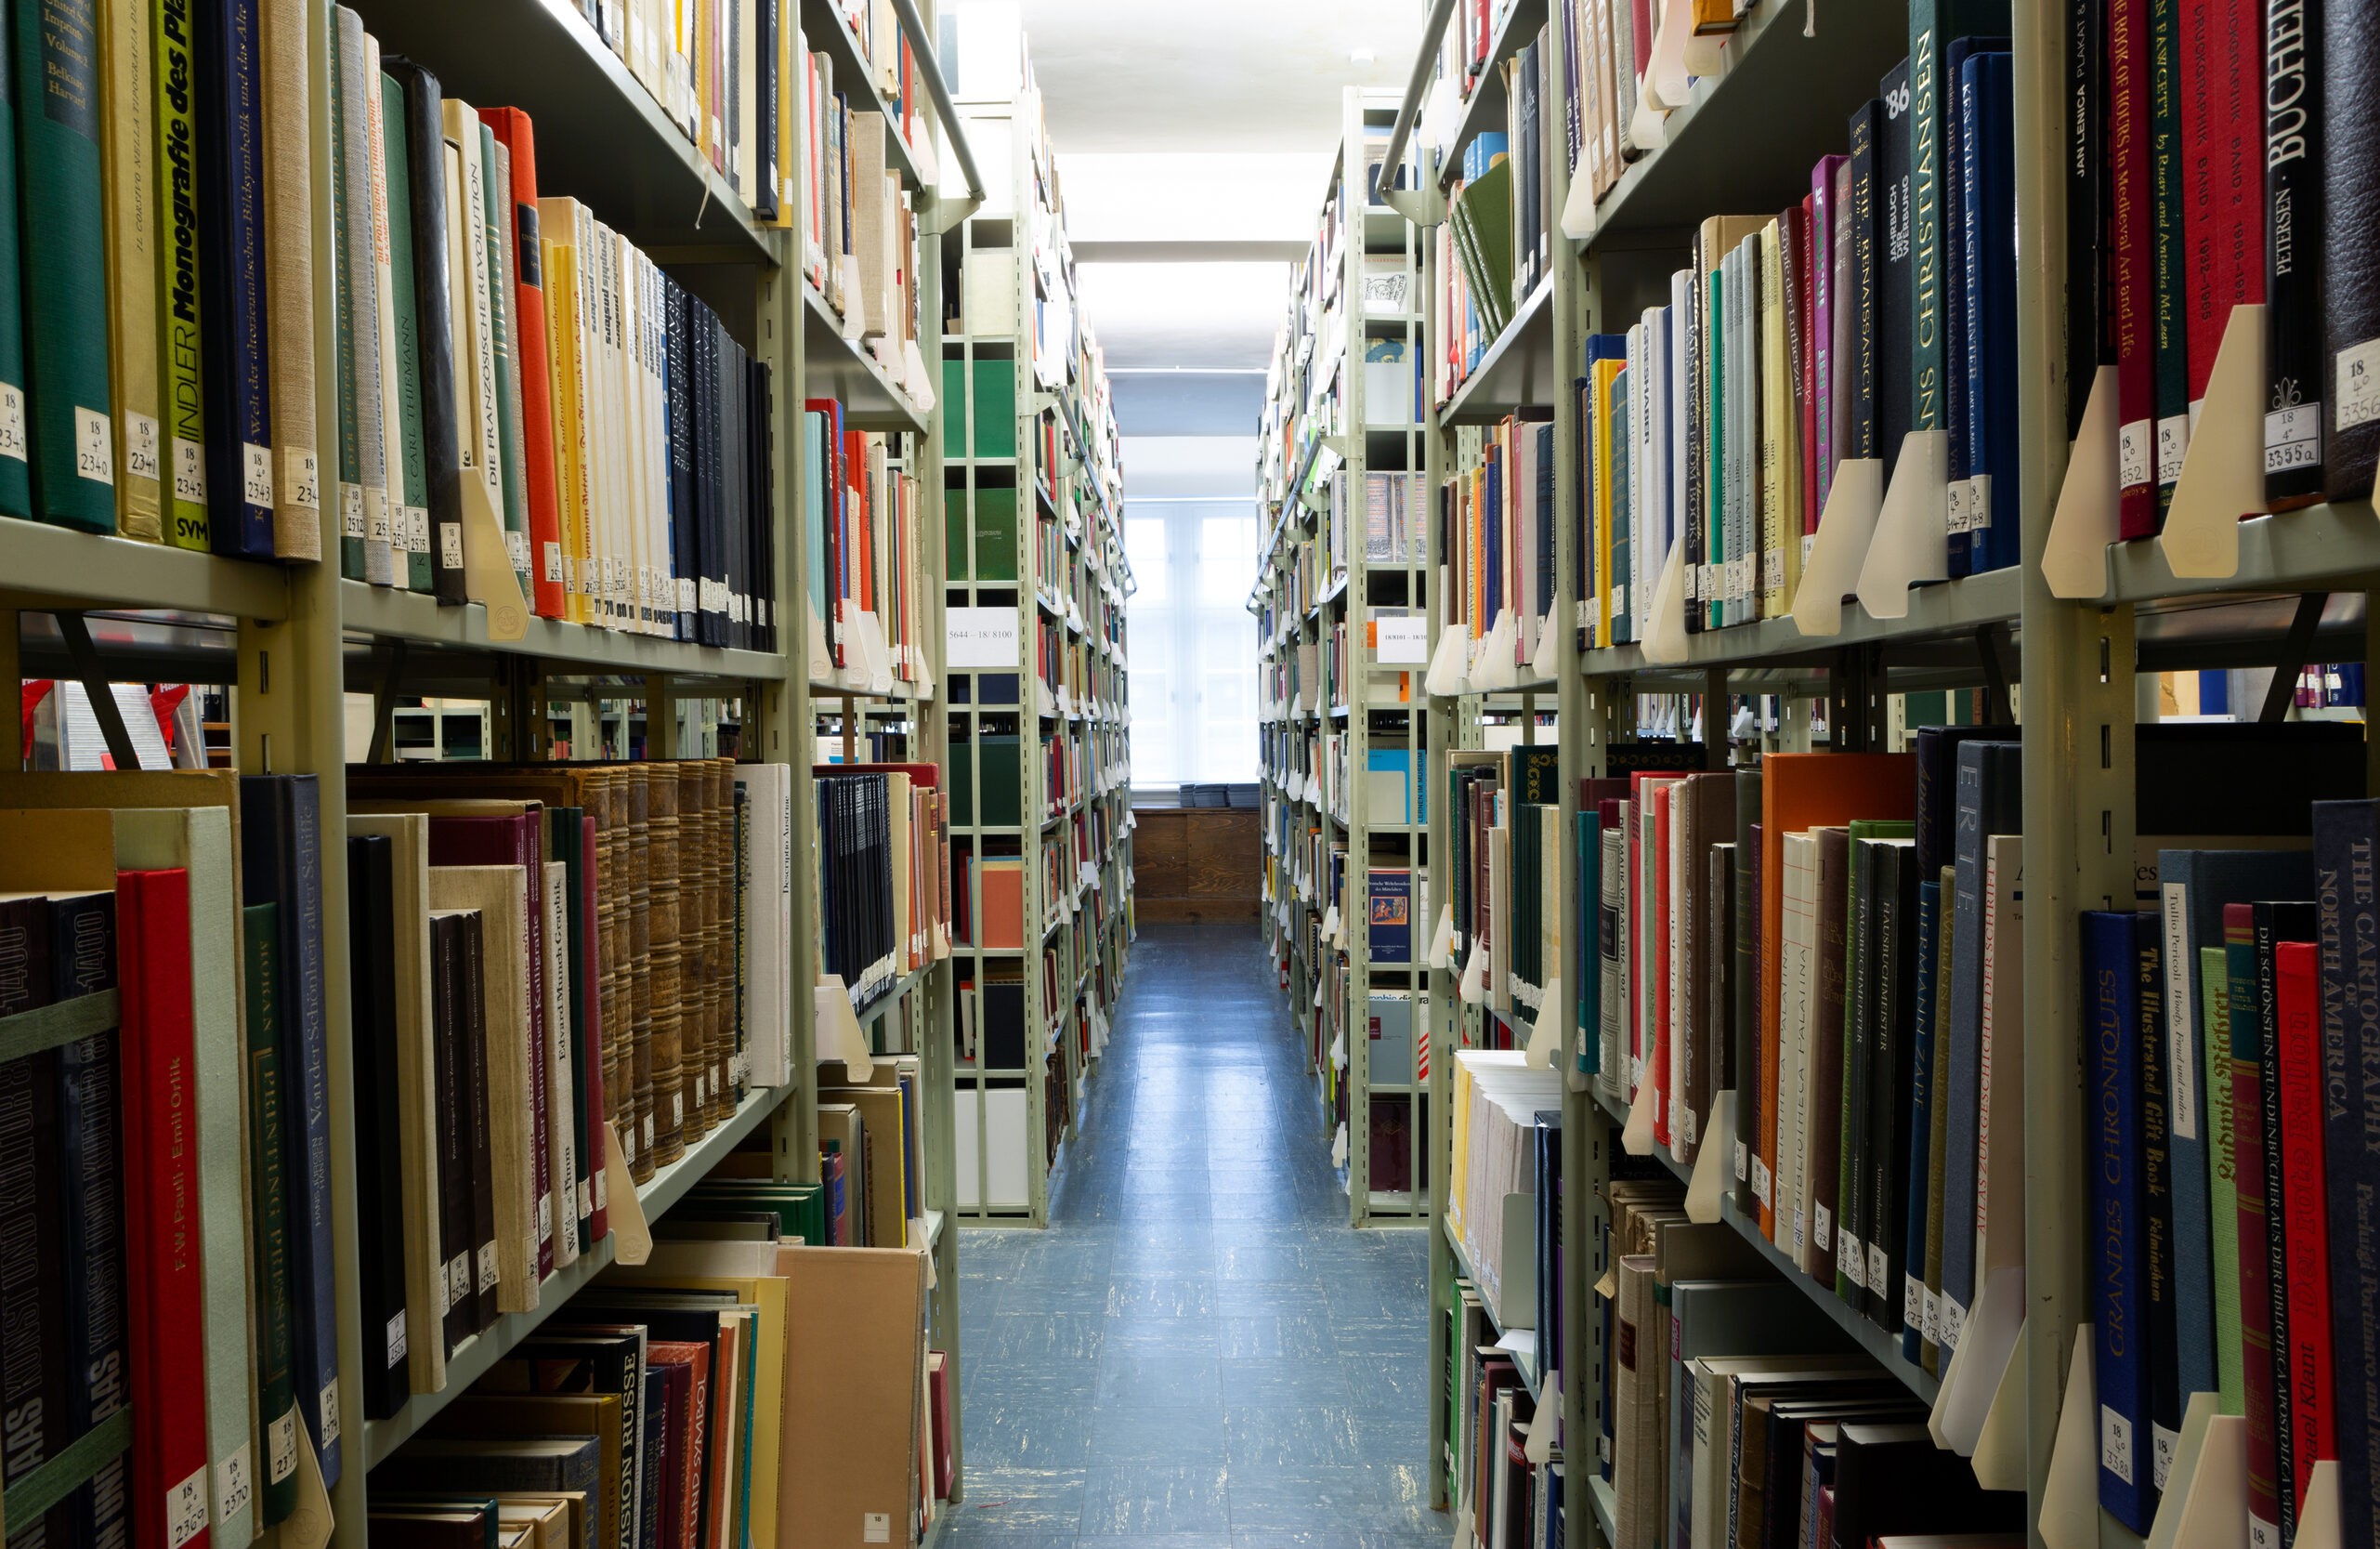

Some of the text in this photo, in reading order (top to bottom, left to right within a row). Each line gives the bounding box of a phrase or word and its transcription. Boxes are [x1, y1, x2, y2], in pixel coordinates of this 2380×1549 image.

[236, 42, 255, 225] Bildsymbolik und das
[2076, 19, 2086, 177] JAN LENICA PLAKAT
[2194, 4, 2208, 208] DRUCKGRAPHIK BAND
[165, 48, 196, 323] Monografie des
[369, 98, 383, 244] POLITISCHE LITHOGRAPHIE
[1916, 29, 1935, 348] CHRISTIANSEN
[2115, 20, 2135, 359] BOOK OF HOURS in Medieval Art and Life
[2155, 22, 2172, 349] FAWCETT by Ruari and Antonia McLean
[2229, 137, 2243, 206] BAND 2
[1890, 184, 1898, 263] JAHRBUCH
[1902, 175, 1910, 255] WERBUNG
[1963, 82, 1978, 379] KEN TYLER MASTER PRINTER
[2276, 188, 2292, 276] PETERSEN
[471, 164, 499, 487] DIE FRANZÖSISCHE REVOLUTION
[602, 288, 612, 347] posters
[1780, 224, 1790, 275] Köpfe
[1787, 310, 1803, 399] Lutherzeit
[1861, 173, 1871, 401] THE RENAISSANCE
[401, 316, 420, 479] CARL THIEMANN
[2350, 360, 2365, 376] 18
[89, 421, 100, 435] 18
[139, 422, 150, 436] 18
[185, 447, 195, 461] 18
[2122, 436, 2131, 450] 18
[2161, 428, 2171, 442] 18
[2269, 444, 2315, 468] 3355a
[2281, 412, 2295, 424] 18
[81, 453, 108, 476] 2340
[177, 478, 203, 497] 2342
[248, 481, 271, 503] 2343
[254, 453, 263, 466] 18
[1688, 434, 1697, 482] FROM
[177, 518, 208, 542] SVM
[1689, 487, 1698, 549] BOOKS
[949, 630, 968, 639] 5644
[782, 838, 791, 895] Descriptio
[2170, 892, 2179, 929] Tullio
[260, 939, 274, 1032] MORAN
[299, 805, 323, 1129] Von der Schönheit alter Schiffe
[554, 878, 566, 1060] Edvard Munch Graphik
[1780, 941, 1788, 1045] PALATINA
[1857, 898, 1867, 1044] HAUSBUCHMEISTER
[1879, 901, 1891, 1051] HAUSBUCHMEISTER
[2172, 933, 2182, 982] Pericoli
[2319, 868, 2348, 1121] NORTH AMERICA
[2345, 982, 2358, 1009] OF
[2351, 836, 2380, 1152] THE CARTOGRAPHY
[532, 914, 545, 1118] islamischen Kalligrafie
[1798, 949, 1807, 1052] PALATINA
[1915, 899, 1929, 1110] HERMANN ZAPF
[2174, 989, 2183, 1028] Woody,
[1977, 864, 1996, 1236] ATLAS ZUR GESCHICHTE DER SCHRIFT
[2176, 1030, 2184, 1063] Freud
[169, 1057, 184, 1160] Emil Orlik
[2140, 949, 2166, 1302] The Illustrated Gift Book Felmingham
[2177, 1084, 2187, 1123] andere
[2099, 969, 2125, 1358] CHRONIQUES GRANDES
[2259, 926, 2292, 1482] DIE SCHÖNSTEN STUNDENBÜCHER AUS DER BIBLIOTECA APOSTOLICA
[2285, 1012, 2319, 1411] Klant Der rote Ballon
[1907, 1284, 1915, 1296] 18
[1927, 1299, 1934, 1311] 18
[1950, 1306, 1957, 1319] 18
[622, 1352, 636, 1452] RUSSE
[2112, 1424, 2122, 1438] 18
[229, 1459, 238, 1474] 18
[691, 1372, 707, 1526] UND SYMBOL
[2107, 1449, 2130, 1478] 3388
[175, 1508, 204, 1544] 2369
[182, 1483, 193, 1500] 18
[225, 1484, 248, 1517] 2370
